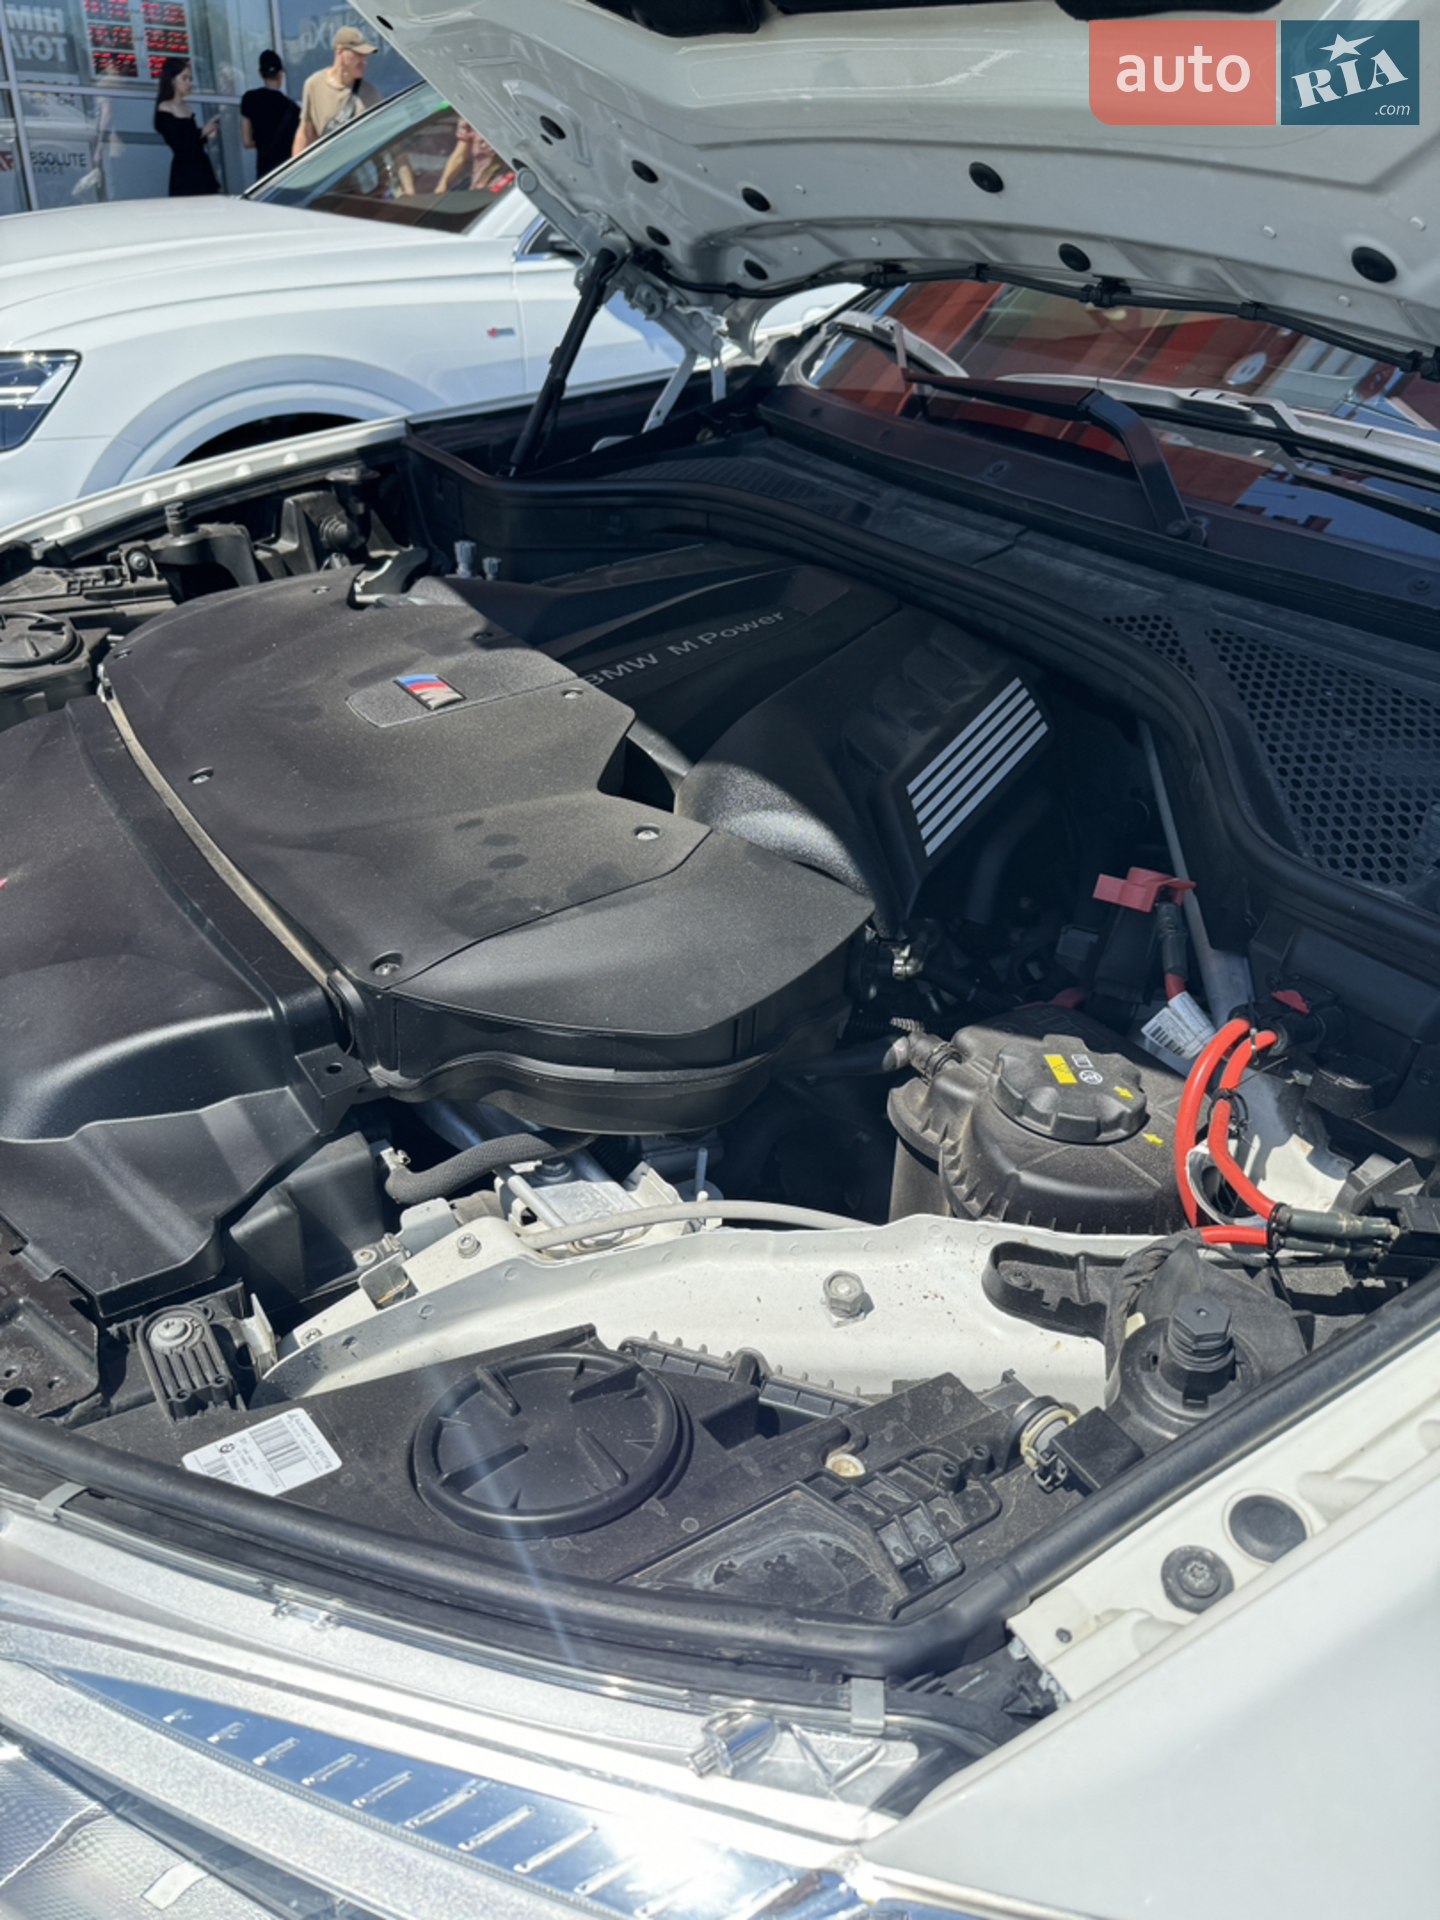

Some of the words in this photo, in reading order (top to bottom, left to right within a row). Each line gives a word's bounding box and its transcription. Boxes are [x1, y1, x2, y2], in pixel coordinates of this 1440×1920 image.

[584, 653, 659, 686] BMW
[667, 640, 699, 656] M
[697, 611, 785, 645] Power
